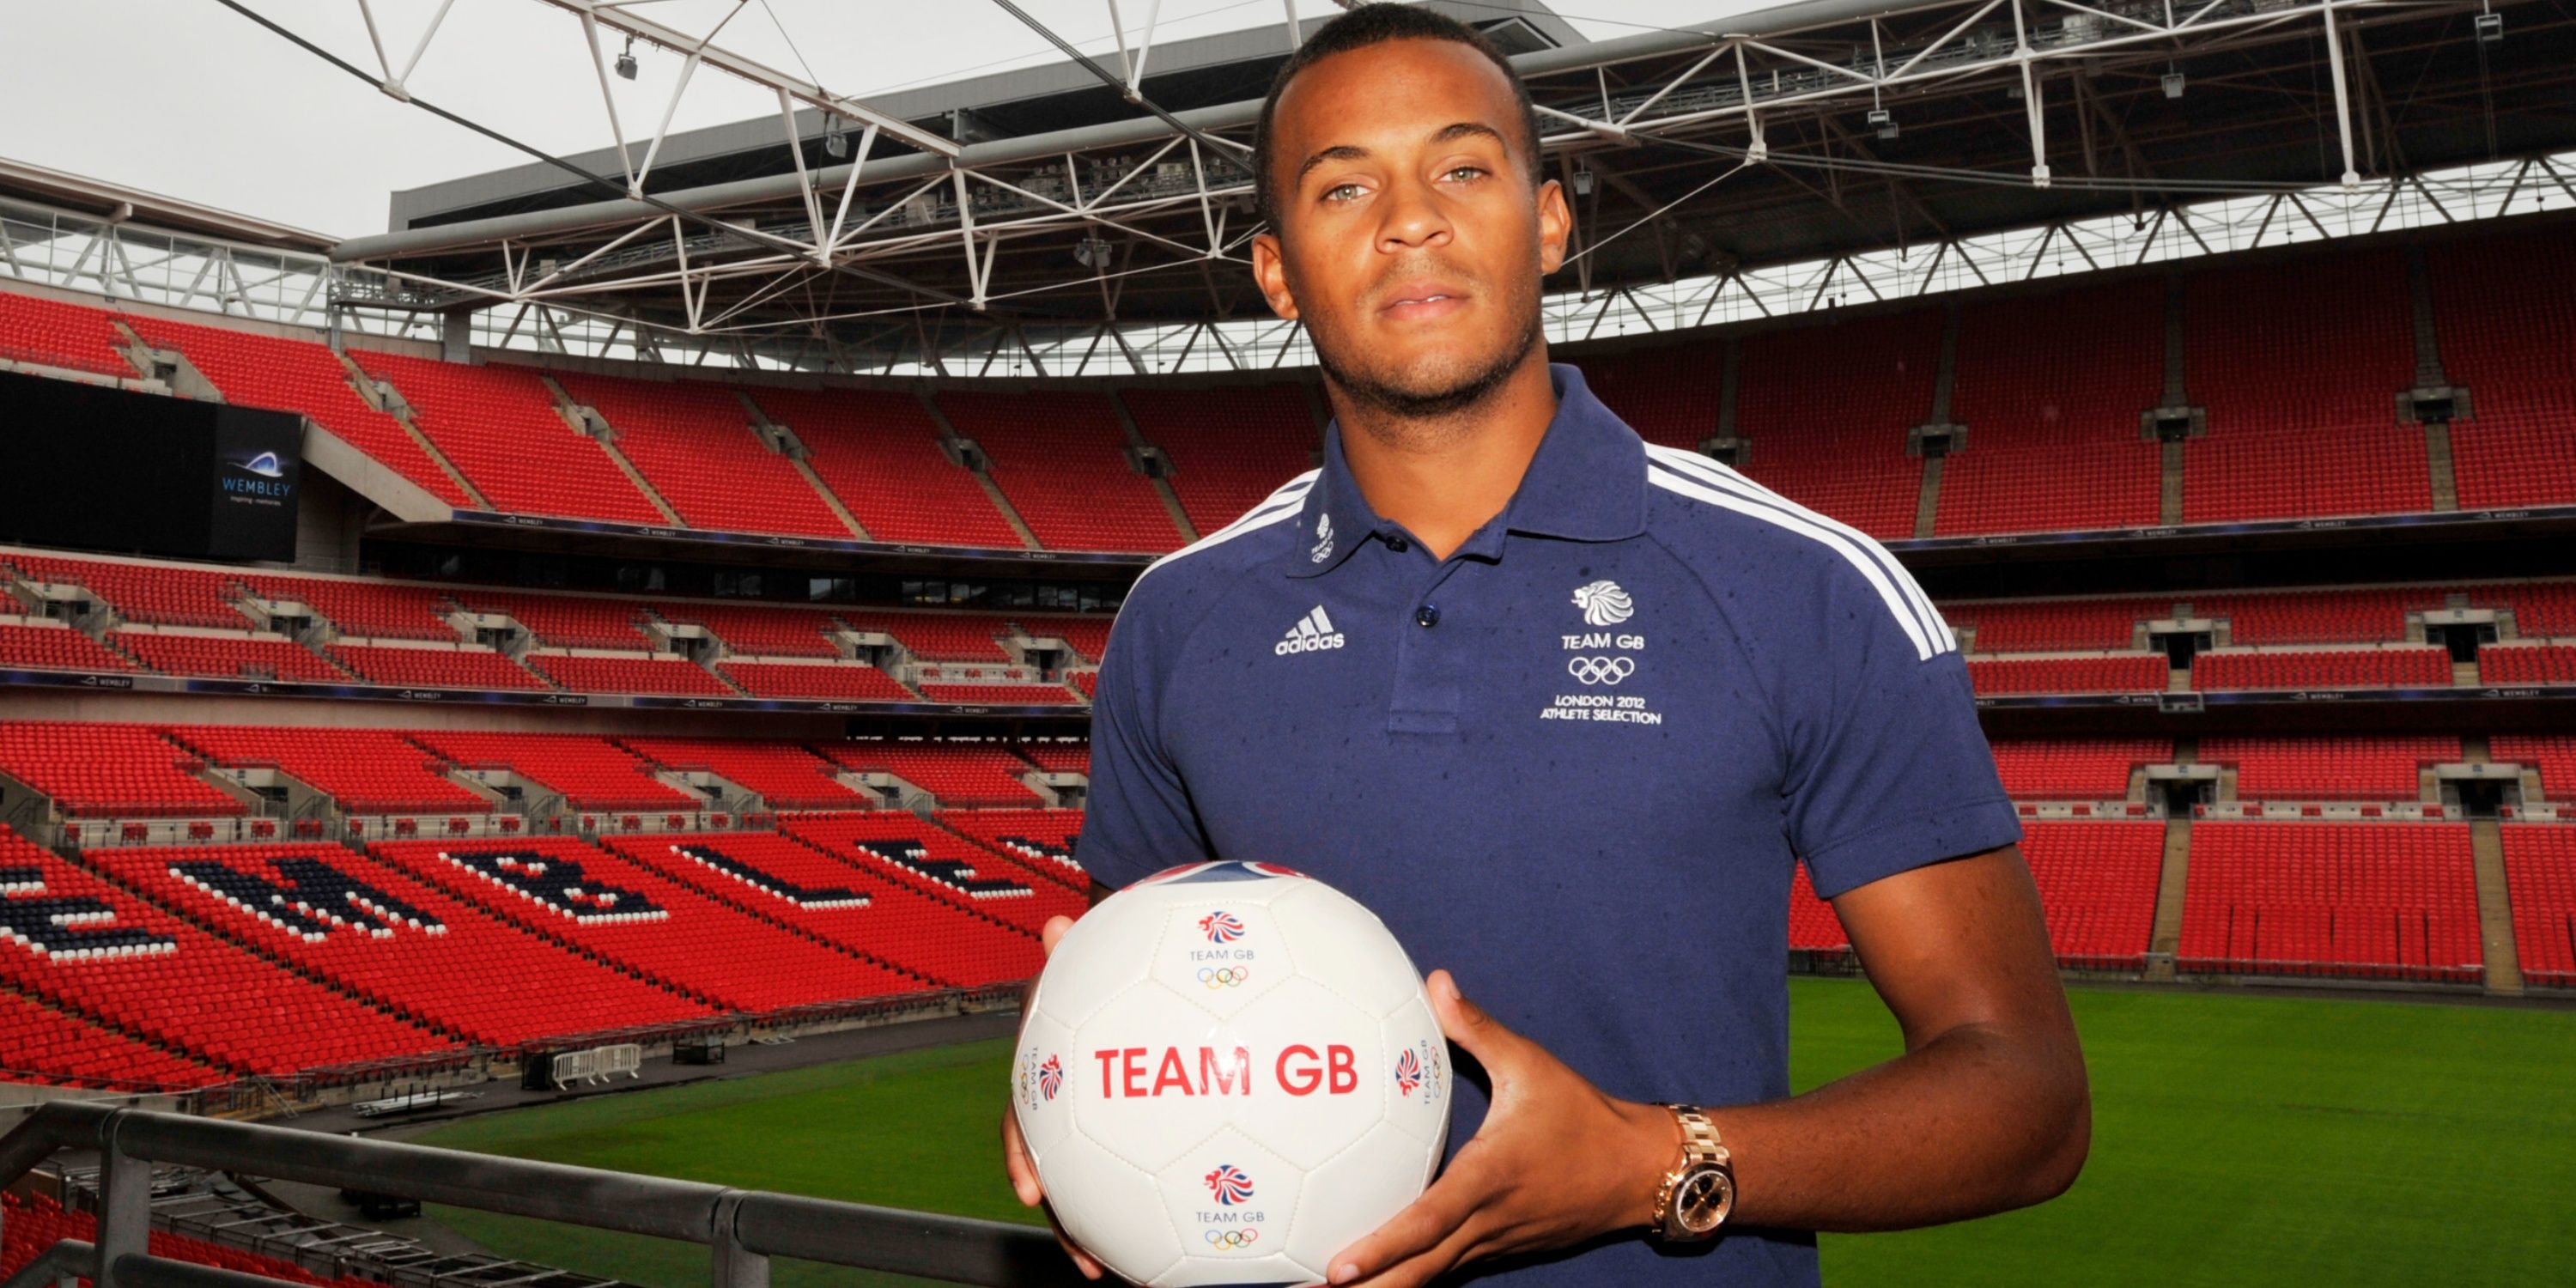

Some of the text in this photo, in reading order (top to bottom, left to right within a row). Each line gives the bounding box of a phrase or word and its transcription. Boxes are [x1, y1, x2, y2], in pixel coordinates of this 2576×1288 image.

[222, 477, 290, 495] WEMBLEY
[1275, 632, 1345, 655] adidas
[1561, 633, 1644, 649] TEAM GB
[1555, 695, 1645, 708] LONDON 2012
[1540, 708, 1662, 724] ATHLETE SELECTION
[1190, 949, 1255, 961] TEAM GB
[1095, 1044, 1358, 1098] TEAM GB
[1196, 1211, 1265, 1223] TEAM GB
